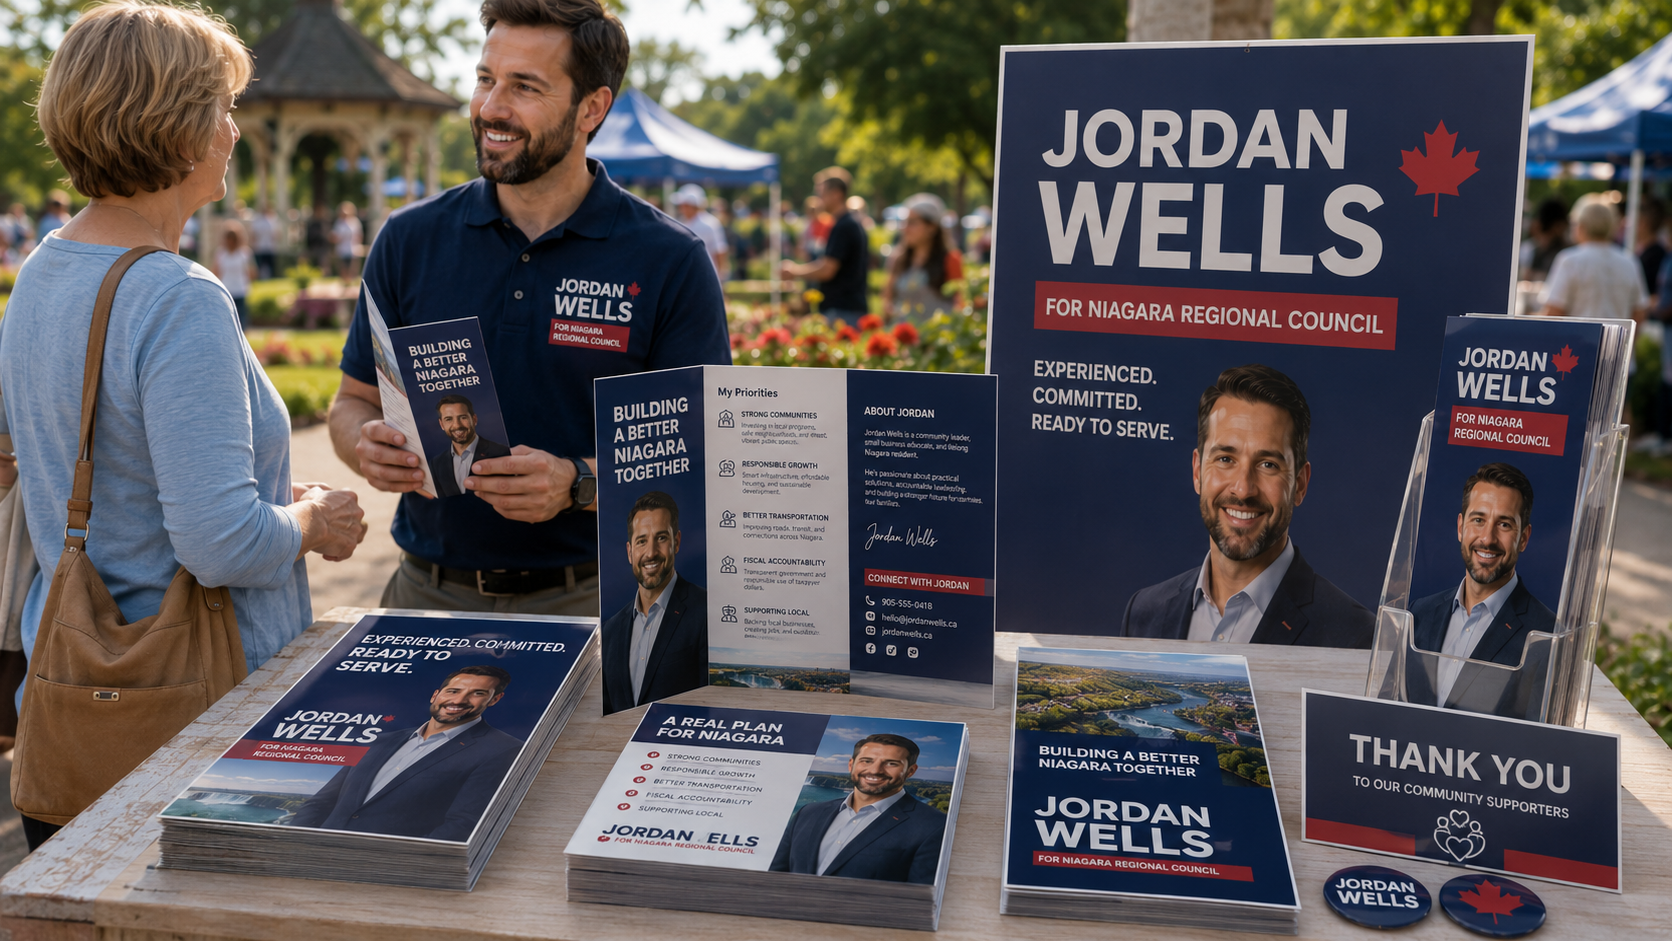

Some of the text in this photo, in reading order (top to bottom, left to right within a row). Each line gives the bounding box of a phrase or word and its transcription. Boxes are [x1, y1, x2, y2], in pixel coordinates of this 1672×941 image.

[1042, 108, 1348, 170] JORDAN
[1038, 180, 1385, 277] WELLS
[556, 278, 624, 298] JORDAN
[554, 294, 633, 322] WELLS
[1045, 297, 1384, 334] FOR NIAGARA REGIONAL COUNCIL
[554, 323, 569, 331] FOR
[408, 338, 472, 357] BUILDING
[413, 352, 467, 369] A BETTER
[1458, 347, 1548, 372] JORDAN
[415, 364, 476, 382] NIAGARA
[1034, 360, 1157, 385] EXPERIENCED.
[418, 376, 481, 393] TOGETHER
[717, 387, 778, 399] My Priorities
[1457, 371, 1557, 405] WELLS
[1033, 387, 1142, 411] COMMITTED.
[613, 397, 688, 422] BUILDING
[769, 411, 818, 419] COMMUNITIES
[864, 406, 935, 418] ABOUT JORDAN
[1031, 413, 1175, 441] READY TO SERVE.
[1456, 412, 1523, 429] FOR NIAGARA
[613, 418, 679, 443] A BETTER
[1454, 428, 1551, 447] REGIONAL COUNCIL
[614, 437, 687, 464] NIAGARA
[614, 457, 690, 484] TOGETHER
[742, 460, 818, 469] RESPONSIBLE GROWTH
[742, 511, 829, 521] BETTER TRANSPORTATION
[864, 522, 938, 551] Jordan Wells
[768, 558, 826, 567] ACCOUNTABILITY
[868, 573, 970, 590] CONNECT WITH JORDAN
[744, 607, 810, 617] SUPPORTING LOCAL
[881, 598, 933, 610] 905-555-0418
[361, 634, 567, 653] EXPERIENCED. COMMITTED.
[348, 647, 452, 661] READY TO
[335, 660, 413, 674] SERVE.
[284, 710, 383, 726] JORDAN
[662, 716, 784, 733] A REAL PLAN
[272, 722, 383, 744] WELLS
[656, 727, 785, 746] FOR NIAGARA
[303, 753, 346, 762] COUNCIL
[667, 753, 761, 766] STRONG COMMUNITIES
[1039, 745, 1200, 765] BUILDING A BETTER
[1349, 733, 1571, 794] THANK YOU
[1038, 758, 1196, 777] NIAGARA TOGETHER
[1353, 775, 1569, 819] TO OUR COMMUNITY SUPPORTERS
[638, 805, 724, 818] SUPPORTING LOCAL
[1034, 795, 1211, 828] JORDAN
[602, 824, 760, 847] JORDAN ELLS
[1034, 819, 1214, 858] WELLS
[634, 839, 672, 847] NIAGARA
[674, 842, 716, 851] REGIONAL
[717, 845, 755, 854] COUNCIL
[1038, 854, 1220, 875] FOR NIAGARA REGIONAL COUNCIL
[1335, 877, 1416, 893] JORDAN
[1336, 890, 1419, 909] WELLS
